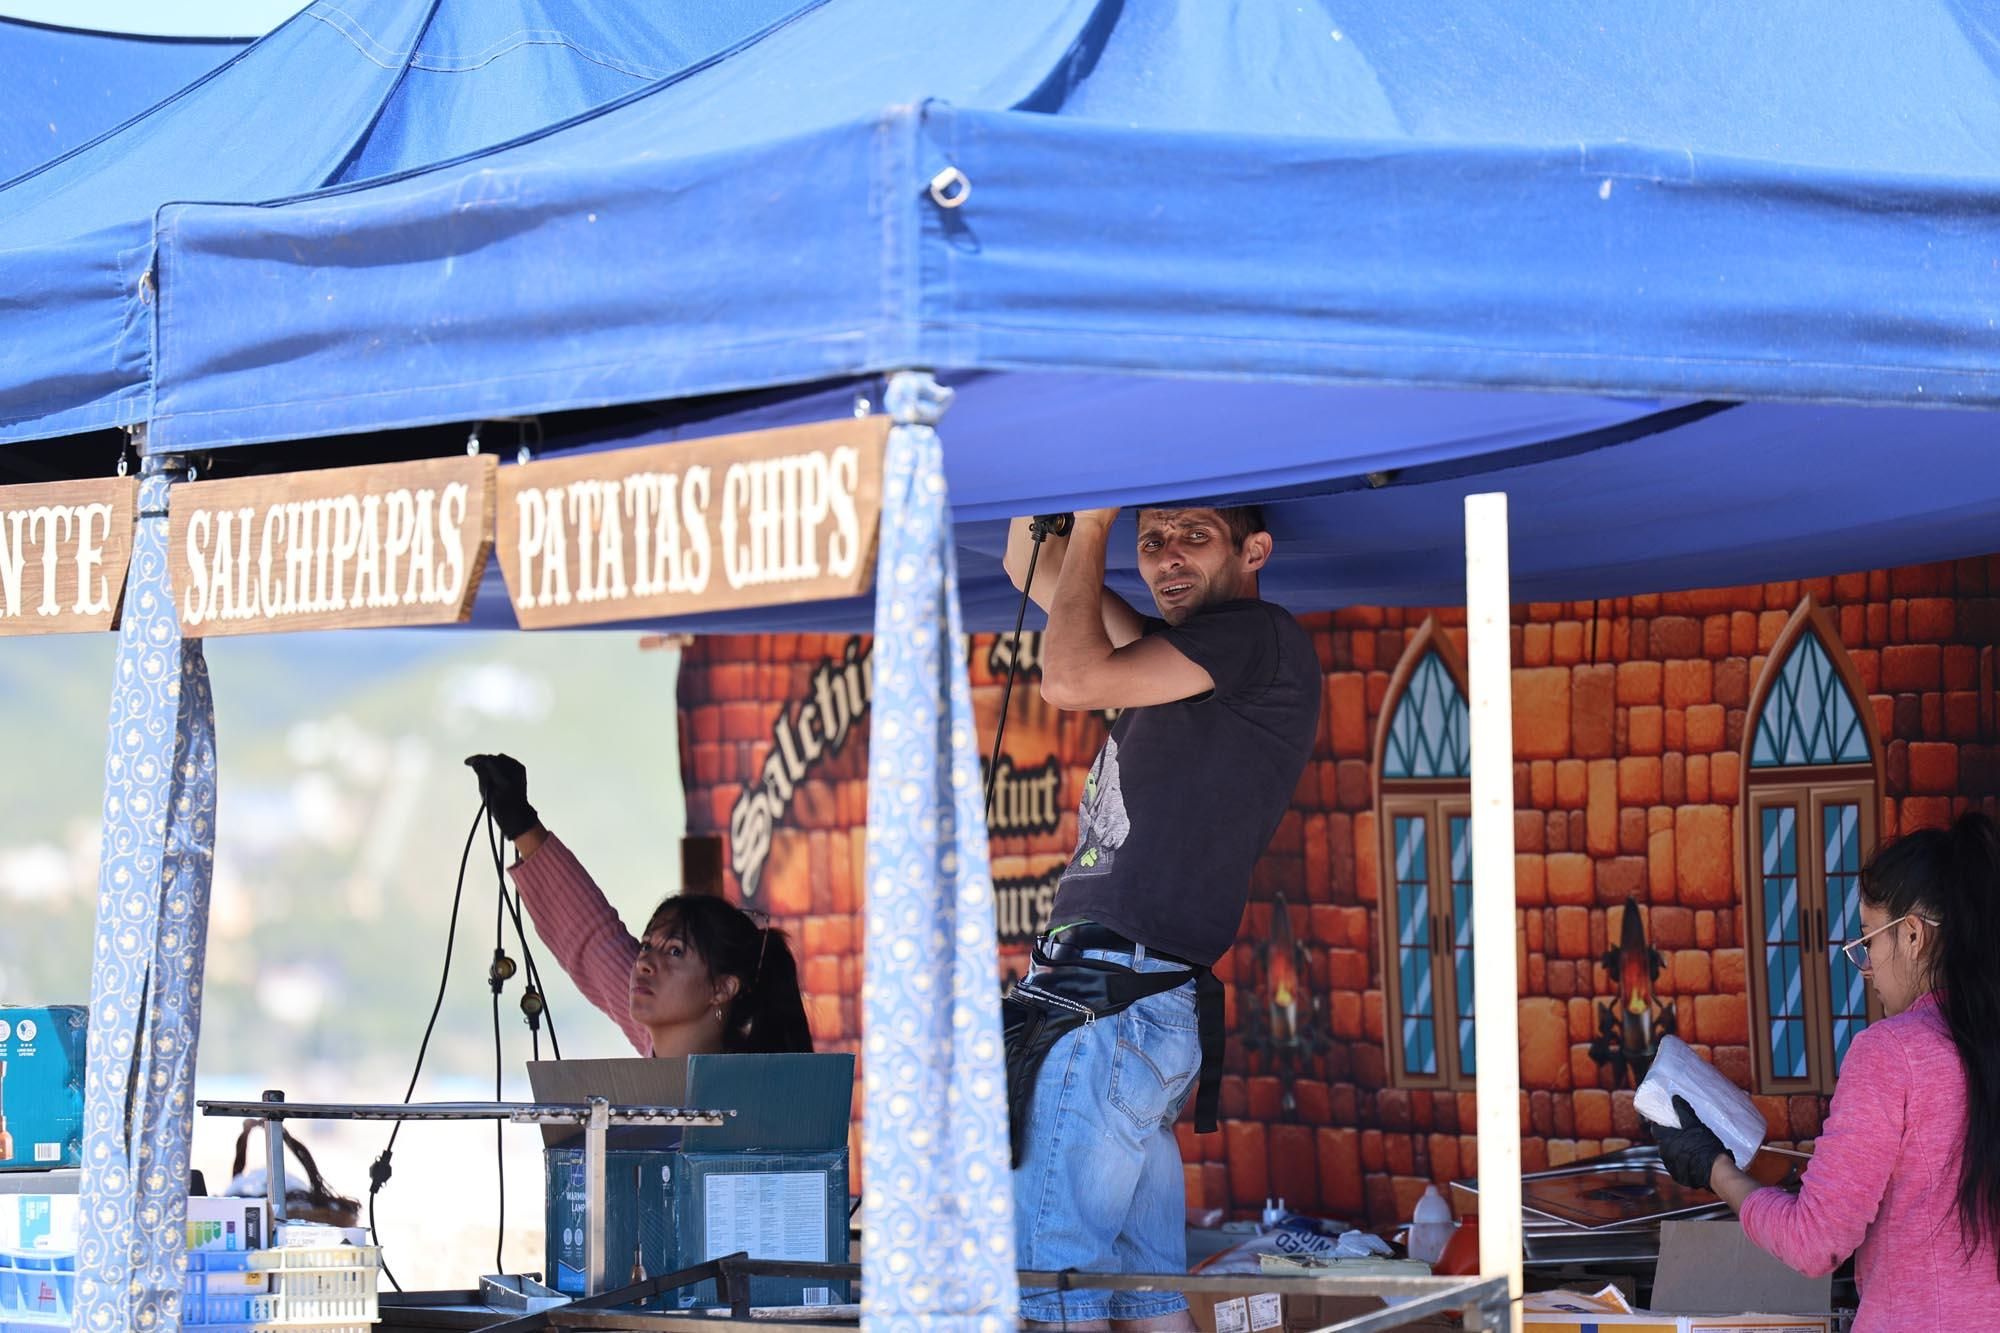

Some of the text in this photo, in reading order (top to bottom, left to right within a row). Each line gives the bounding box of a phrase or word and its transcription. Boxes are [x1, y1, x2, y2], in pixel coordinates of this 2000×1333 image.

[183, 481, 468, 625] SALCHIPAPAS
[516, 446, 860, 609] PATATAS CHIPS
